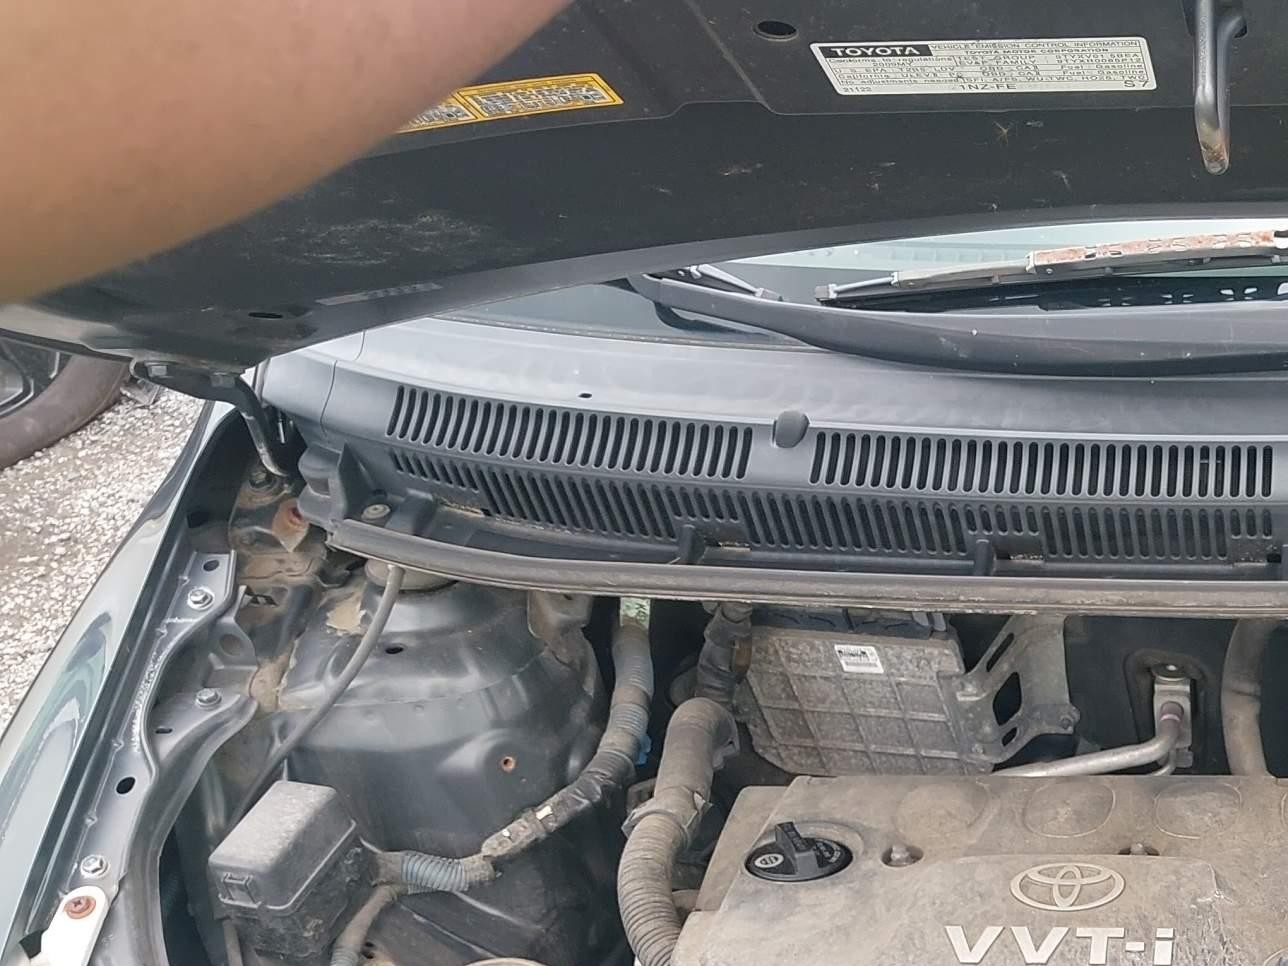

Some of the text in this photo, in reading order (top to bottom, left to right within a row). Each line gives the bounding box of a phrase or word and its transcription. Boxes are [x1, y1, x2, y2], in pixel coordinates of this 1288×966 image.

[831, 46, 920, 57] TOYOTA
[959, 83, 1017, 91] 1NZ-FE
[944, 925, 1174, 966] VVT-i
